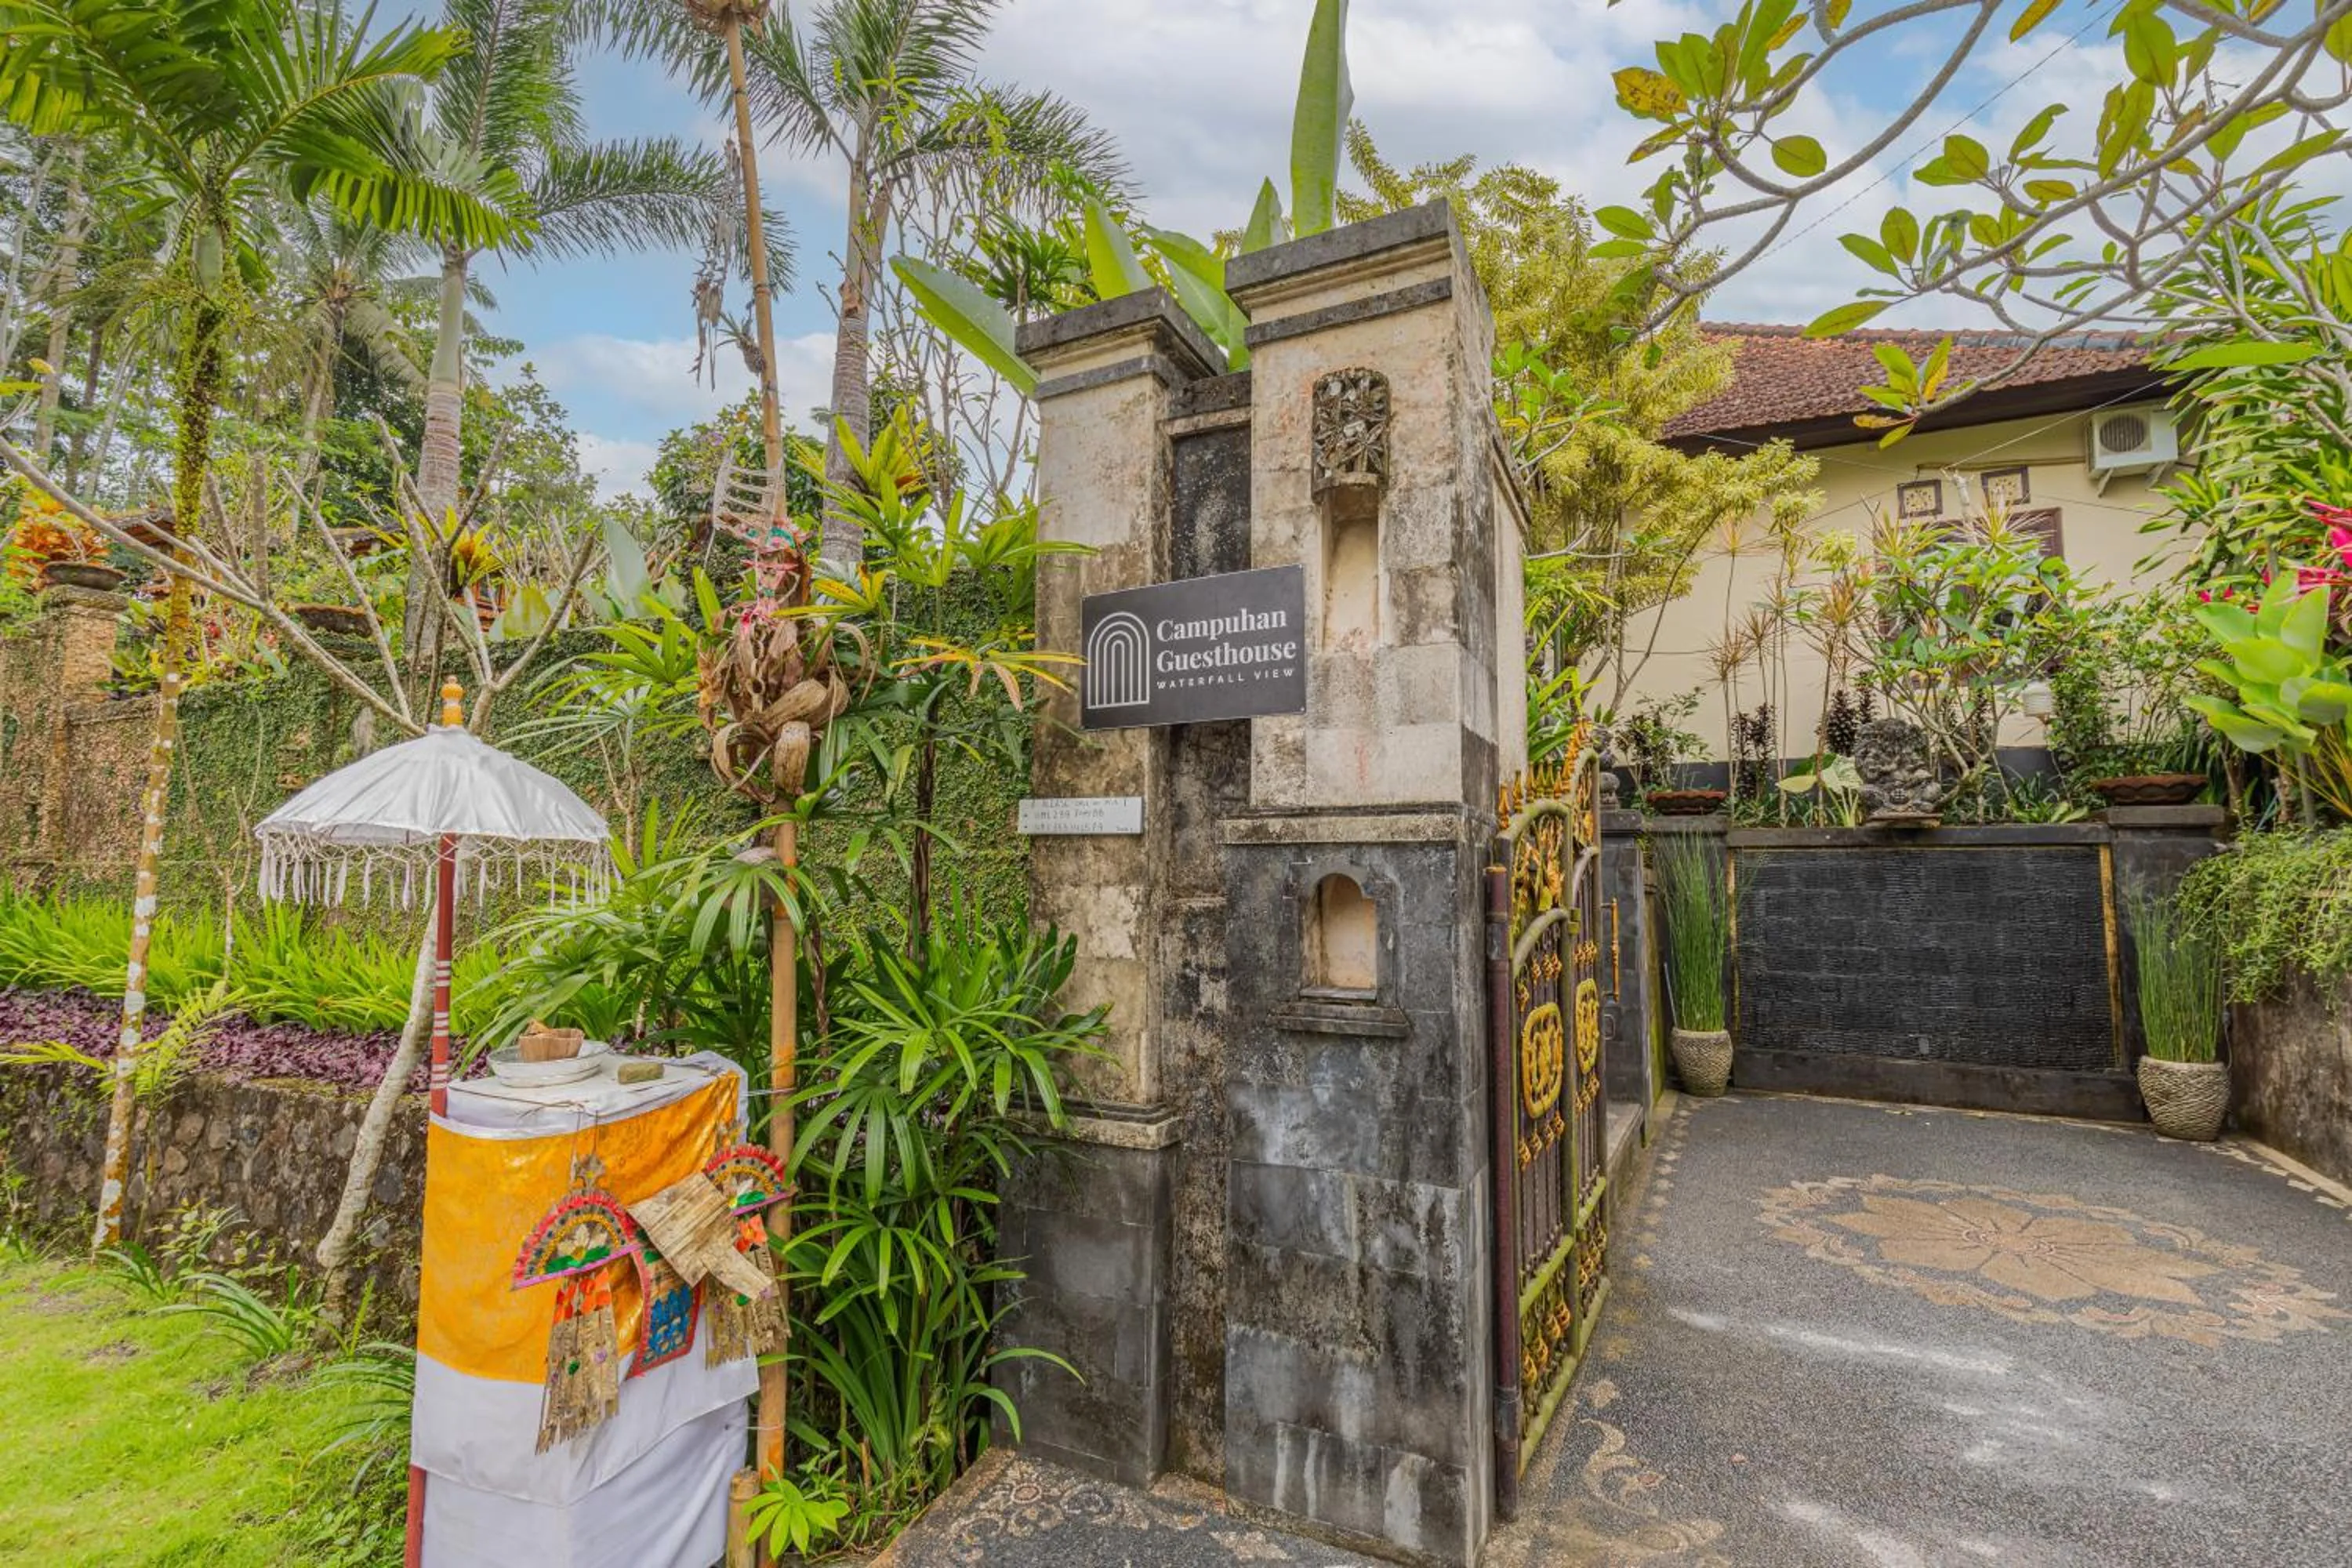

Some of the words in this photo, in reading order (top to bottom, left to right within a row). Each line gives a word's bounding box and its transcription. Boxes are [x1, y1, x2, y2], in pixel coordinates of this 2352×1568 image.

[1156, 608, 1287, 642] Campuhan
[1156, 641, 1296, 672] Guesthouse
[1156, 671, 1245, 690] WATERFALL
[1254, 667, 1294, 681] VIEW
